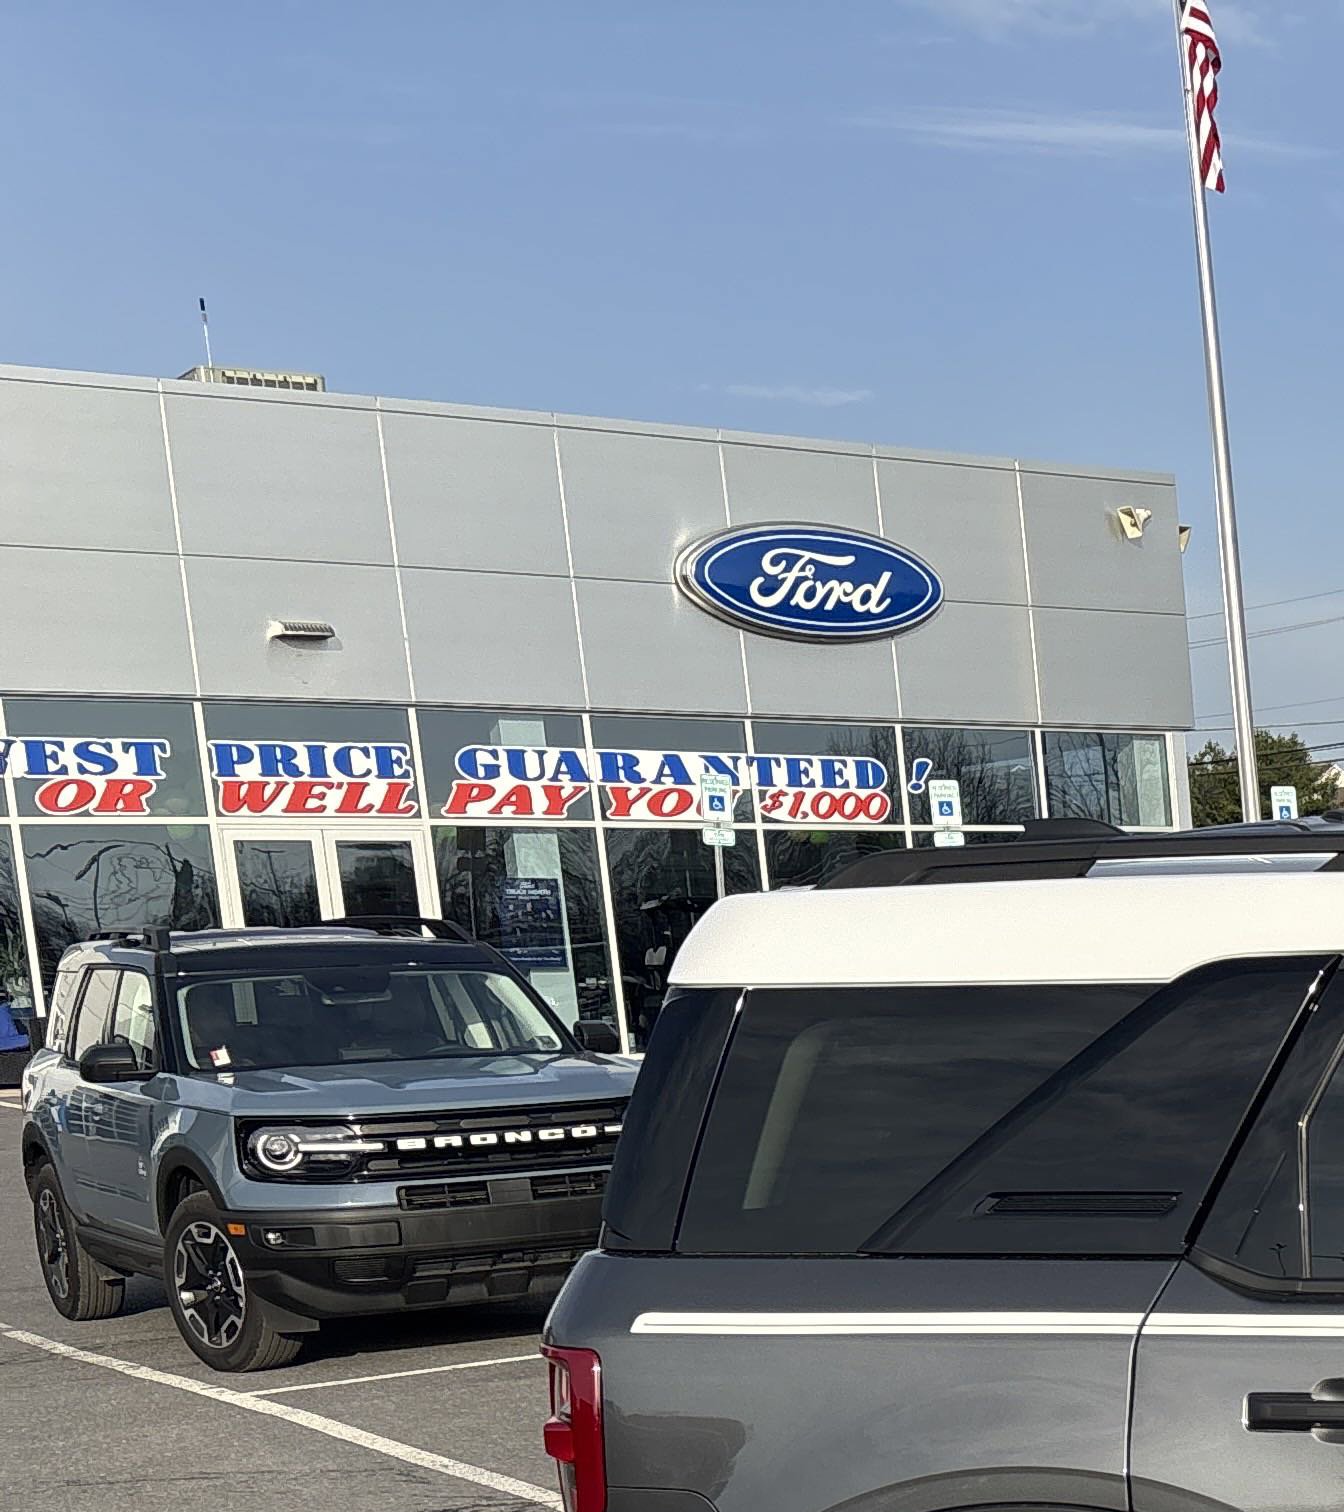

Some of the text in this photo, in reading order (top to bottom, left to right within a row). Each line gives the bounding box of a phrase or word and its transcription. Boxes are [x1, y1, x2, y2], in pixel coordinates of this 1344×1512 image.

[750, 548, 893, 614] Ford
[210, 743, 411, 778] PRICE
[456, 747, 887, 791] GUARANTEED
[38, 778, 888, 820] OR WE'LL PAY YO $1,000
[397, 1126, 597, 1149] BRONCO
